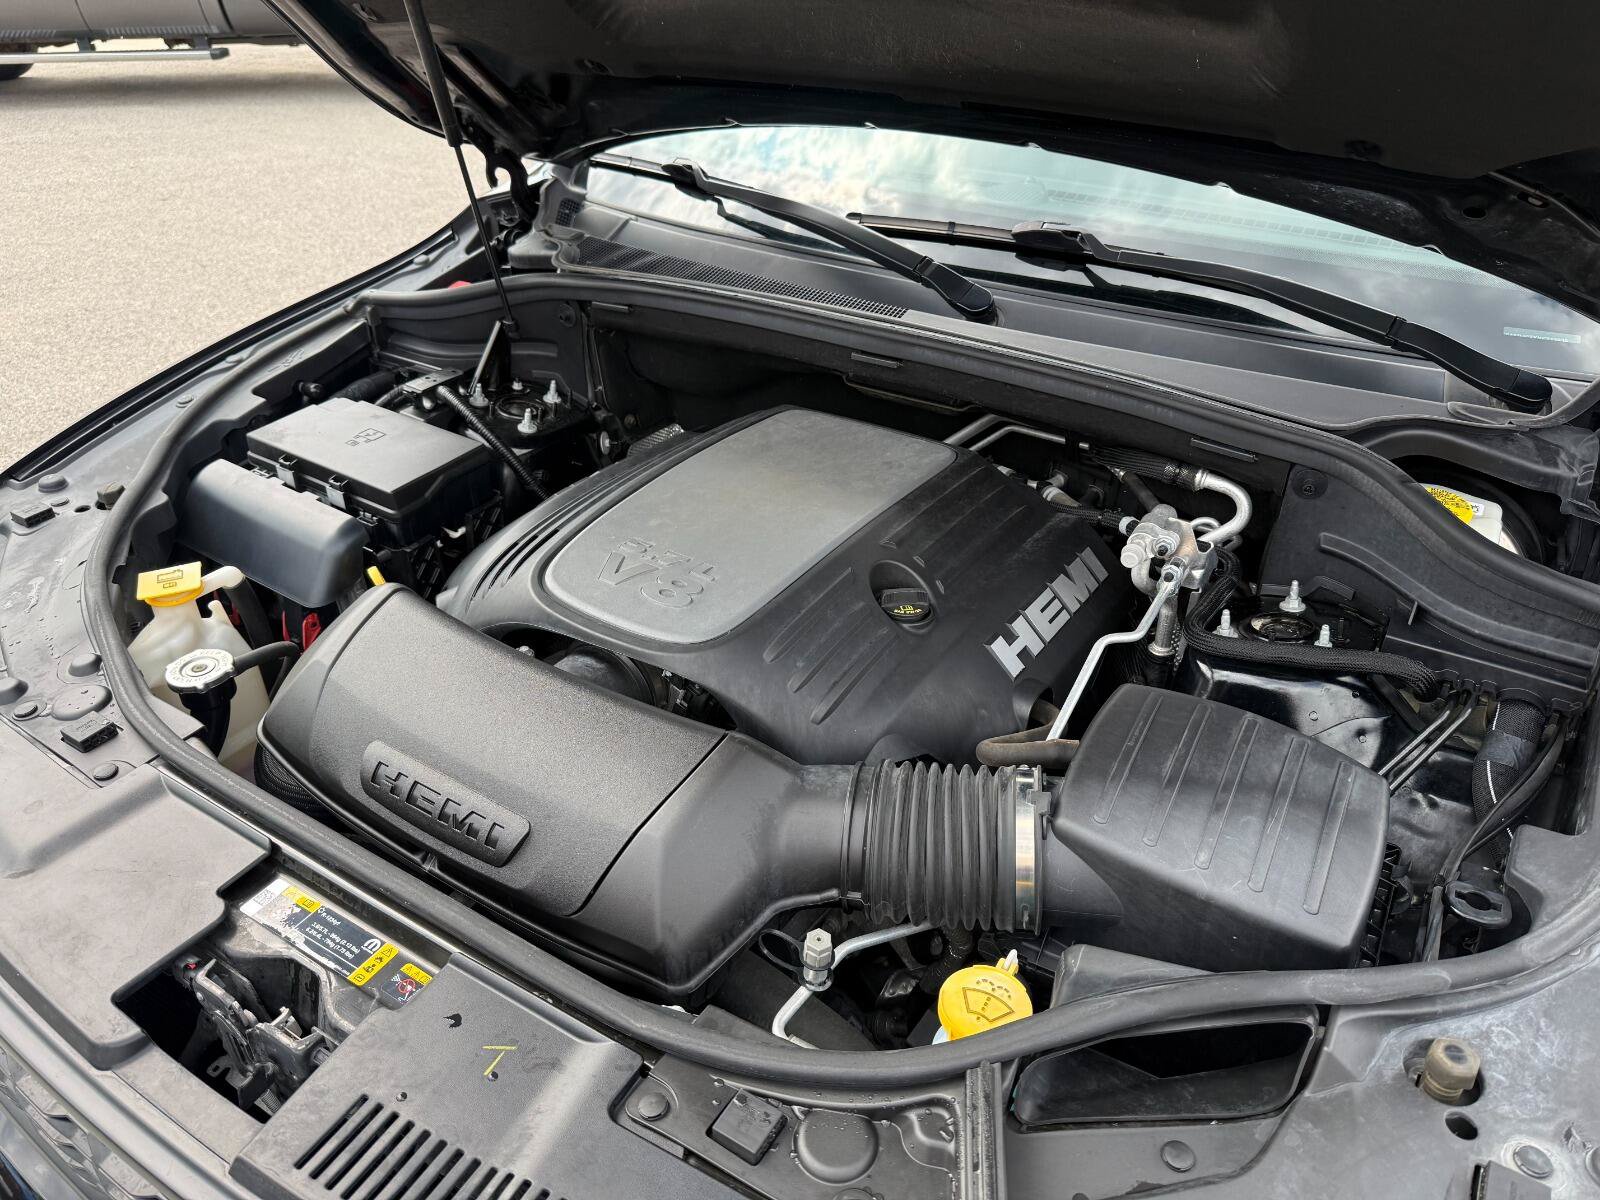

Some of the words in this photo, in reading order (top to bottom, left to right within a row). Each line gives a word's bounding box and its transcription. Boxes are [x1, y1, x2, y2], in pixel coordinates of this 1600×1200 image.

[598, 551, 704, 608] V8
[618, 537, 719, 582] 5.7L
[984, 546, 1109, 680] HEMI
[370, 760, 505, 851] HEMI
